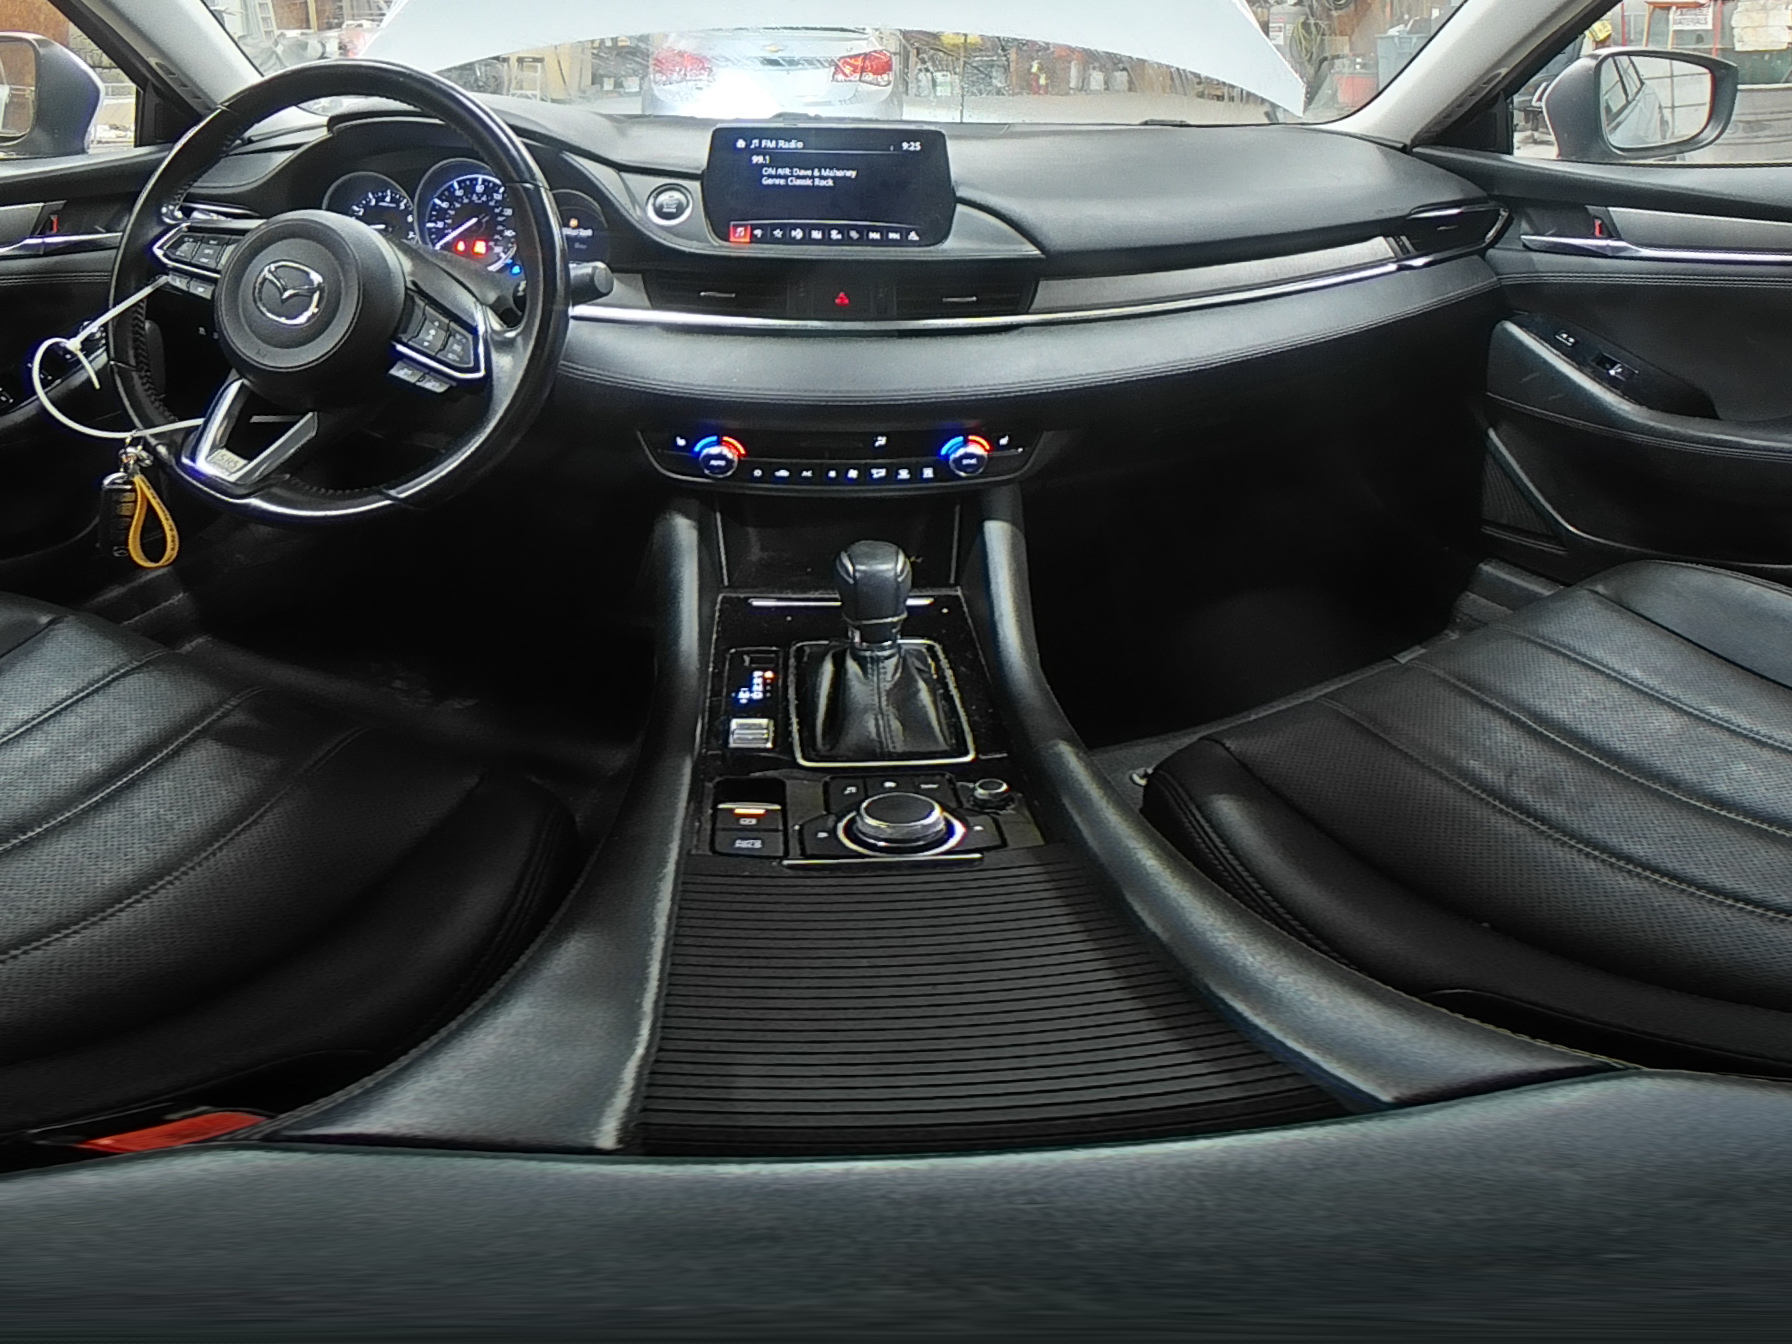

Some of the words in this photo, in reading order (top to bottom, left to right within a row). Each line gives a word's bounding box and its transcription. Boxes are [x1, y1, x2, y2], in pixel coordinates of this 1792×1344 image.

[761, 140, 776, 148] FM
[778, 139, 804, 148] Radio
[901, 141, 922, 151] 9:25
[788, 177, 813, 186] Classic
[814, 178, 834, 186] Rock
